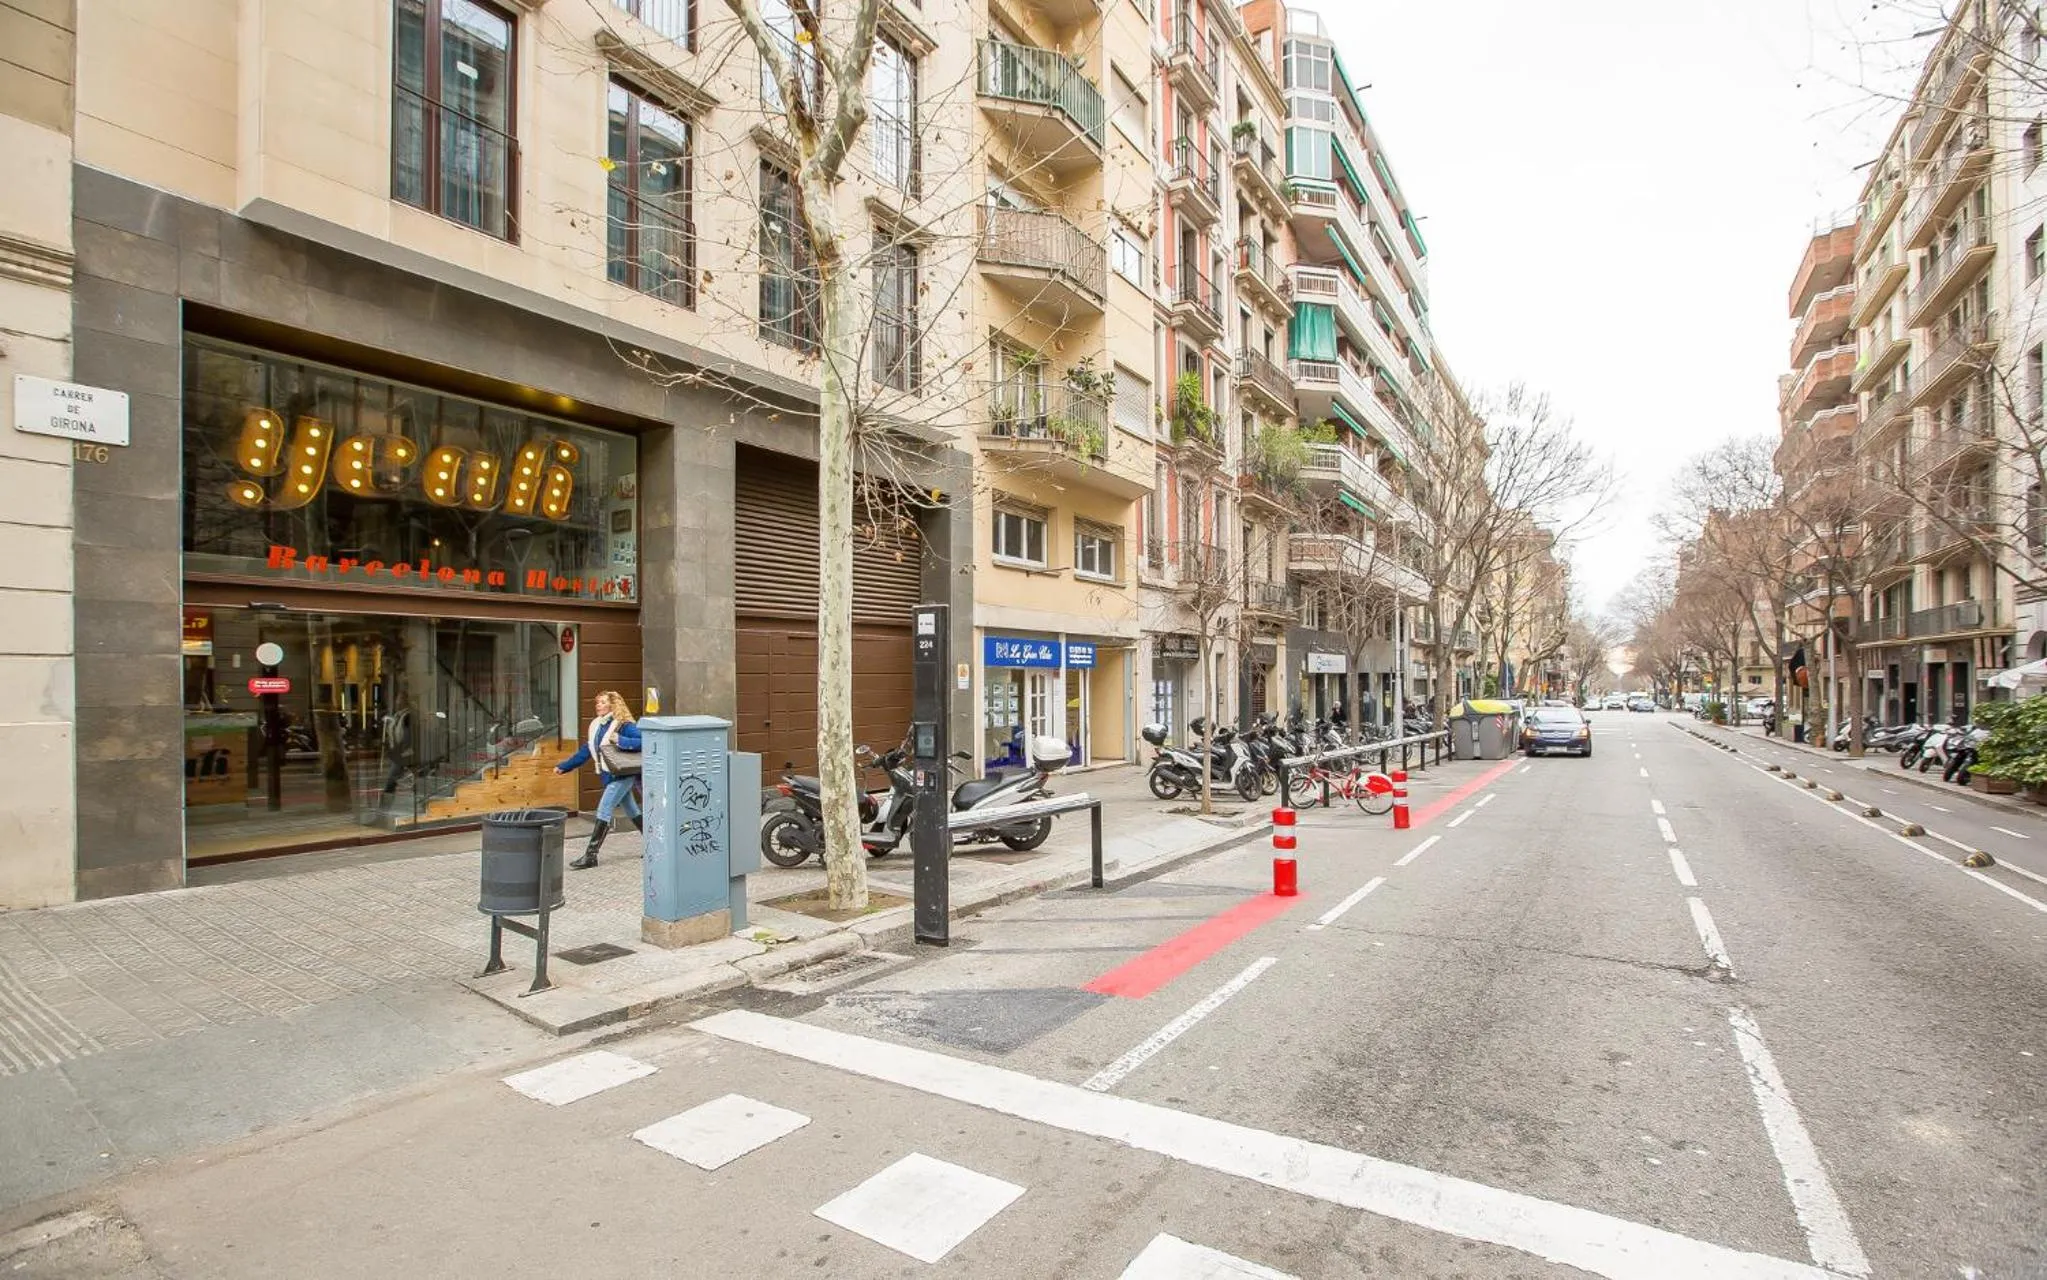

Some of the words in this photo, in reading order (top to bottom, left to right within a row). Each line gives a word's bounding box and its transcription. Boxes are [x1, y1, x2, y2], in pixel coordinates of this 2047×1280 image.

[53, 388, 93, 402] CARRER
[67, 404, 81, 414] DE
[50, 415, 97, 434] GIRONA
[74, 444, 109, 465] 176
[227, 407, 580, 520] yeah
[267, 544, 506, 587] Barcelona
[526, 567, 631, 596] Hostel
[919, 640, 933, 649] 224
